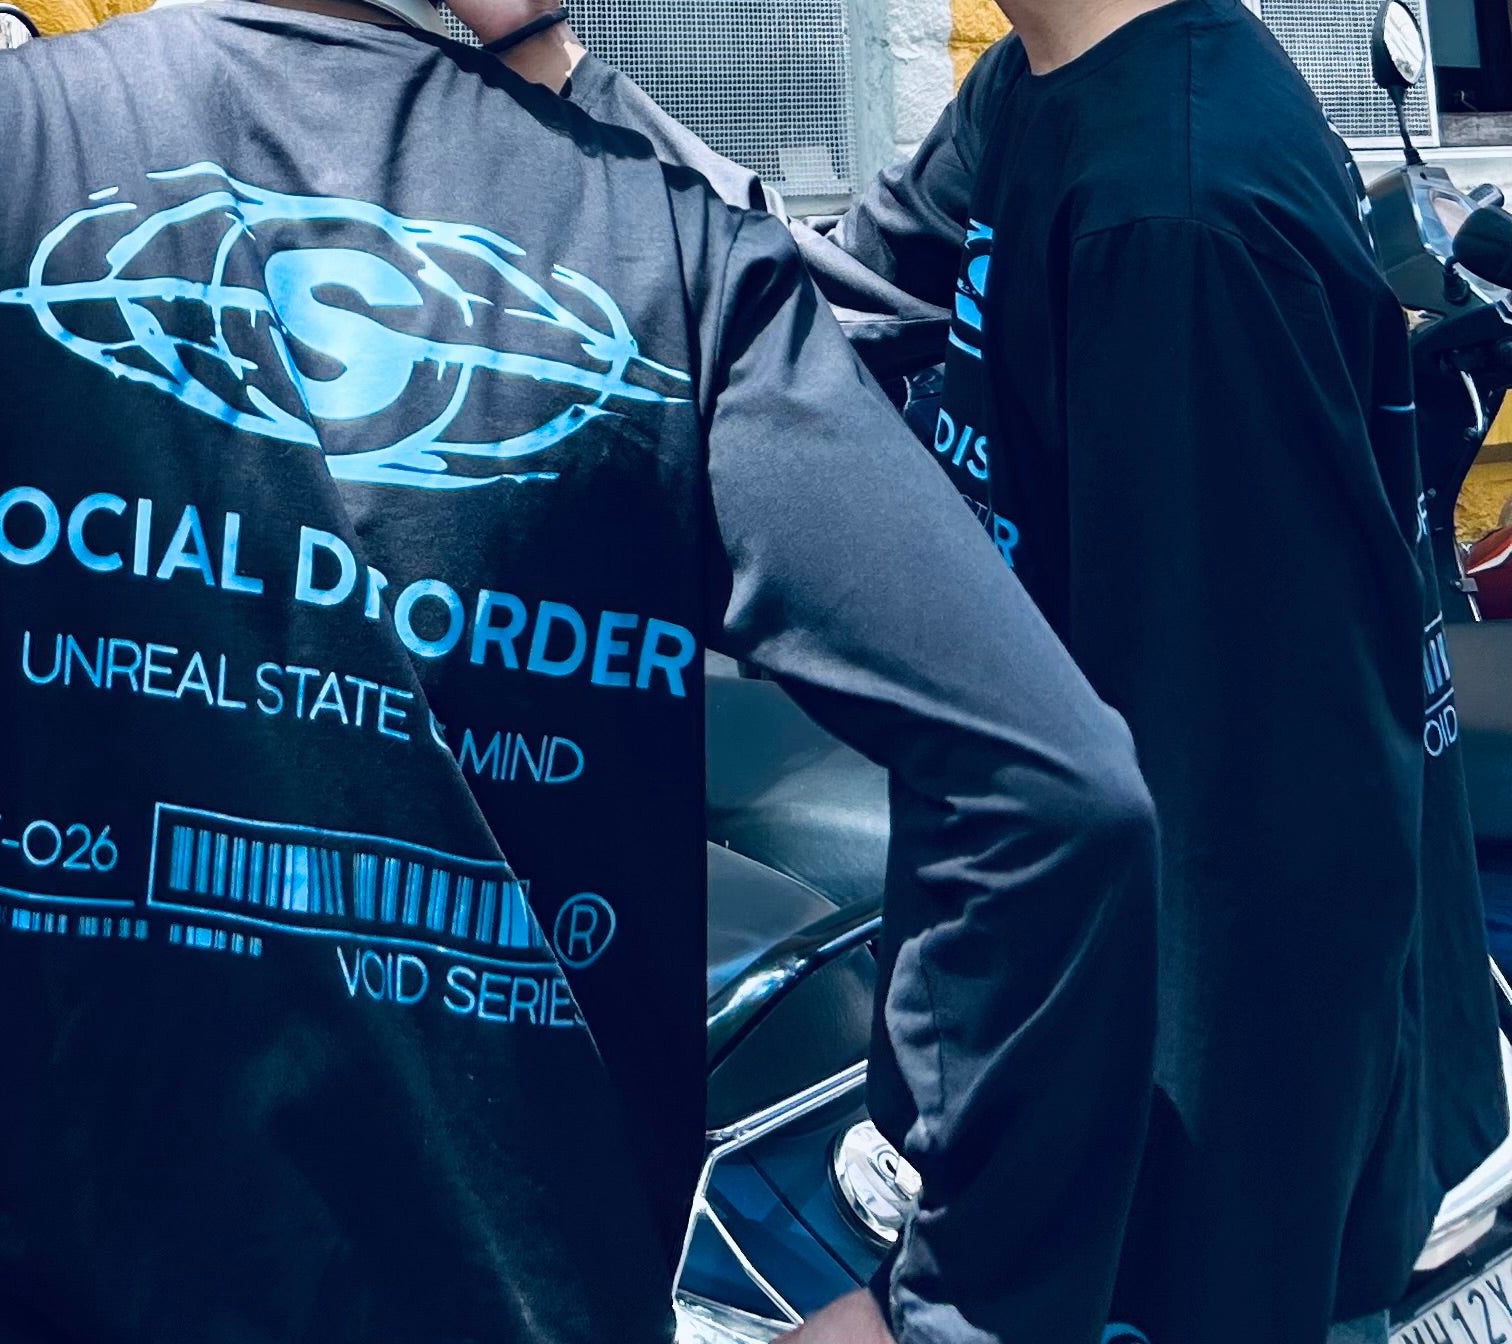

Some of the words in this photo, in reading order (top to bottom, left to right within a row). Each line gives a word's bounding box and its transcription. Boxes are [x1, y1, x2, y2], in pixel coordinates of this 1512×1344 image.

[22, 630, 248, 710] UNREAL
[256, 661, 414, 741] STATE
[459, 727, 585, 784] MIND
[1423, 704, 1458, 758] OID
[337, 946, 430, 1005] VOID
[443, 964, 587, 1028] SERIE
